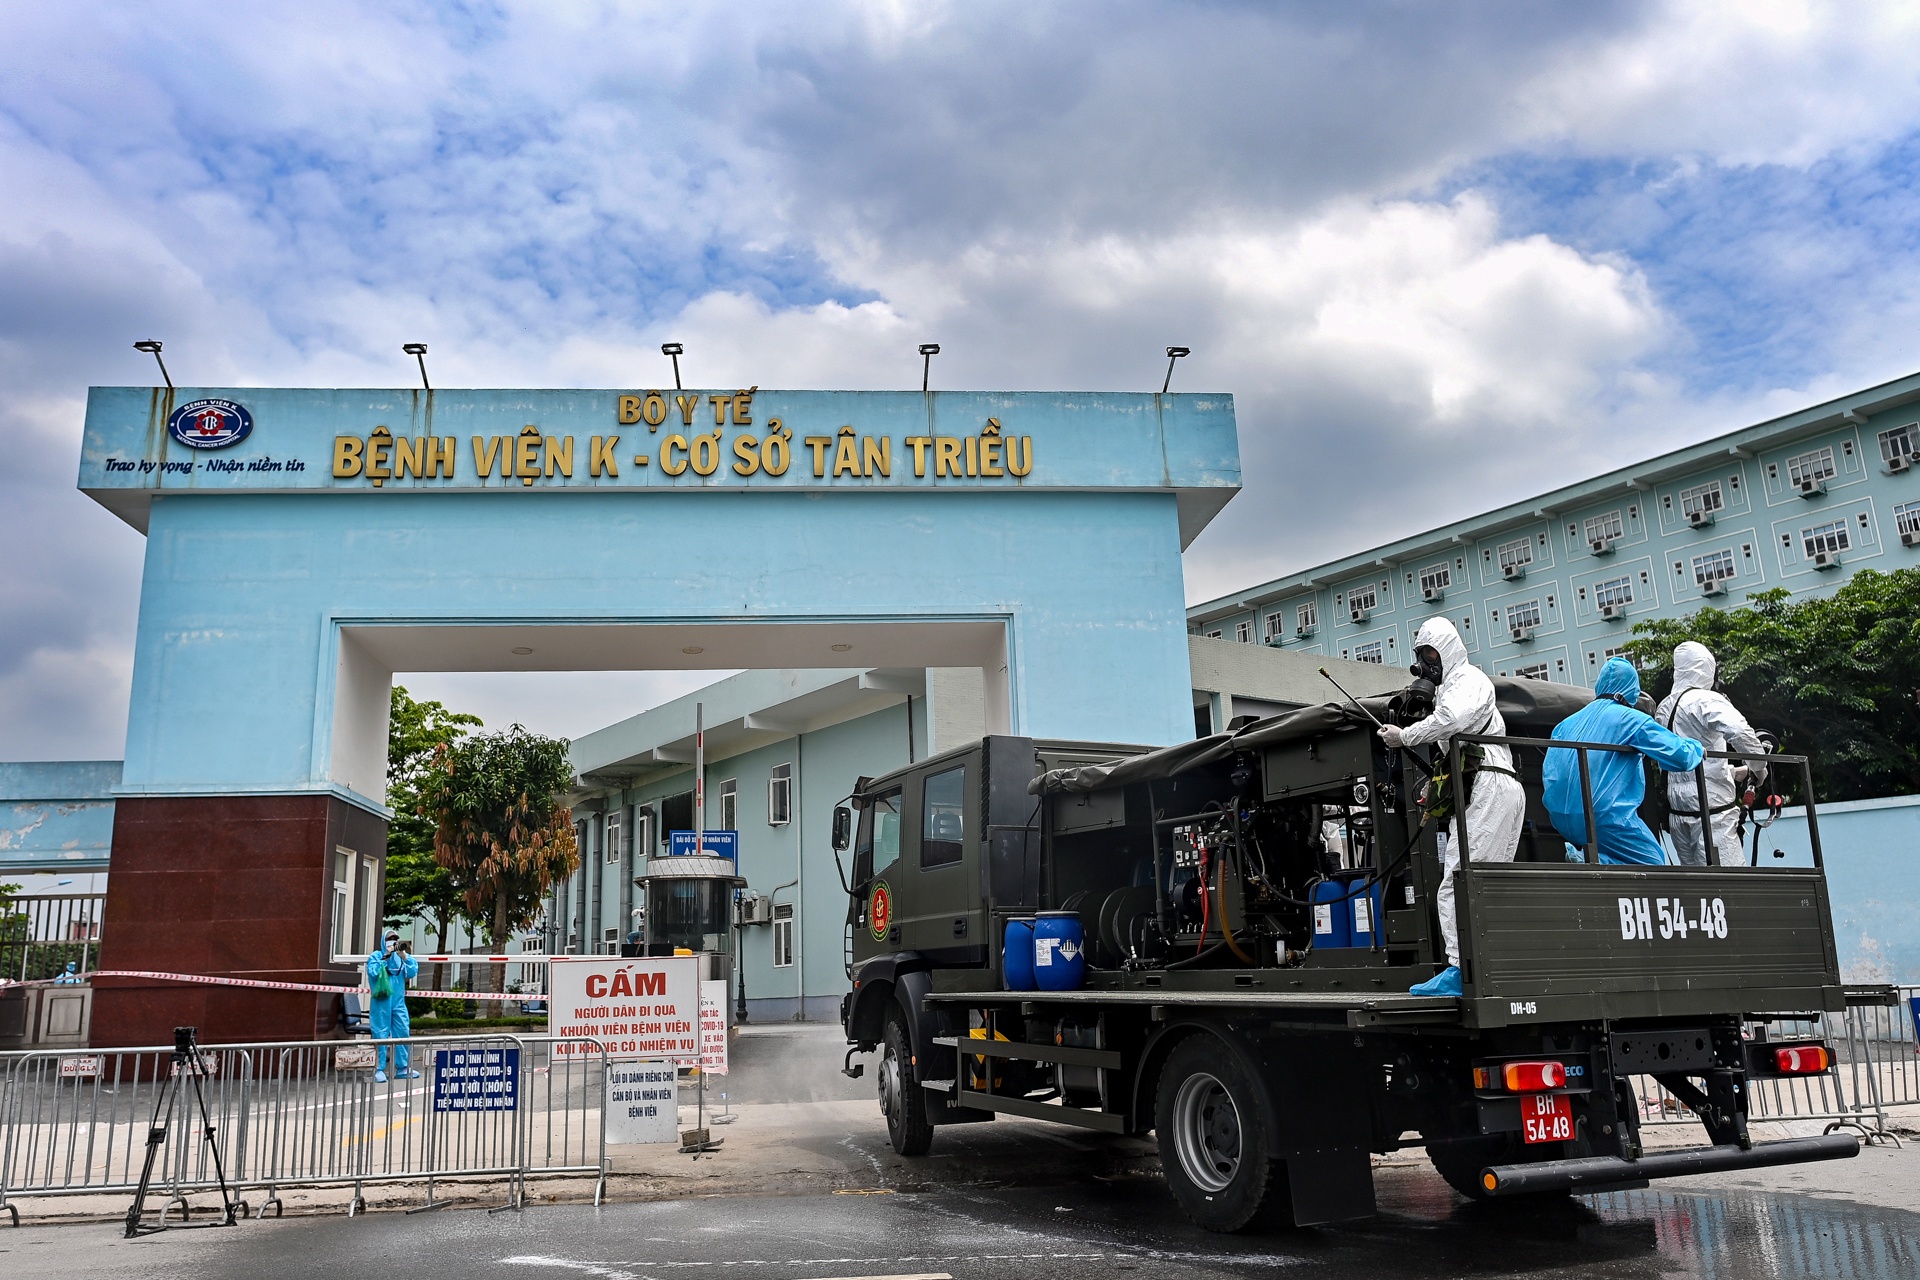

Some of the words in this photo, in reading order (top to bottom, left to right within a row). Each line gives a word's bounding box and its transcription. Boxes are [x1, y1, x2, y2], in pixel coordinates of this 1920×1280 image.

[618, 390, 666, 433] BỘ
[675, 395, 699, 424] Y
[710, 386, 758, 424] TẾ
[176, 434, 197, 447] NATIONAL
[218, 434, 241, 447] HOSPITAL
[333, 426, 455, 487] BỆNH
[471, 426, 574, 486] VIỆN
[590, 436, 620, 477] K
[634, 455, 649, 465] -
[659, 428, 723, 477] CƠ
[732, 418, 793, 477] SỞ
[805, 426, 891, 478] TÂN
[906, 418, 1032, 478] TRIỀU
[105, 459, 135, 472] Trao
[138, 459, 156, 472] hy
[160, 461, 194, 474] vọng
[206, 459, 244, 474] Nhận
[248, 456, 282, 472] niềm
[286, 459, 305, 472] tin
[1618, 897, 1653, 940] BH
[1657, 897, 1728, 939] 54-48
[585, 965, 666, 998] CẤM
[574, 1004, 609, 1019] NGƯỜI
[613, 1004, 636, 1018] DÂN
[639, 1006, 651, 1017] ĐI
[654, 1004, 676, 1016] QUA
[1510, 1002, 1537, 1015] DH-05
[560, 1023, 599, 1037] KHUÔN
[602, 1022, 628, 1036] VIÊN
[631, 1021, 661, 1036] BỆNH
[665, 1019, 690, 1034] VIỆN
[621, 1038, 637, 1052] CÓ
[640, 1037, 676, 1052] NHIỆM
[680, 1039, 695, 1052] VỤ
[713, 1034, 724, 1042] VÀO
[455, 1055, 464, 1064] DO
[441, 1067, 458, 1079] DCH
[622, 1073, 628, 1083] ĐI
[629, 1071, 644, 1083] DÀNH
[645, 1070, 662, 1083] RIÊNG
[663, 1071, 674, 1082] CHO
[1564, 1066, 1584, 1077] ECO
[612, 1089, 624, 1101] CÁN
[625, 1089, 633, 1103] BỘ
[634, 1088, 641, 1101] VÀ
[642, 1088, 657, 1101] NHÂN
[659, 1088, 671, 1100] VIÊN
[629, 1105, 643, 1120] BỆNH
[644, 1104, 657, 1120] VIỆN
[1536, 1095, 1555, 1115] BH
[1526, 1116, 1570, 1141] 54-48
